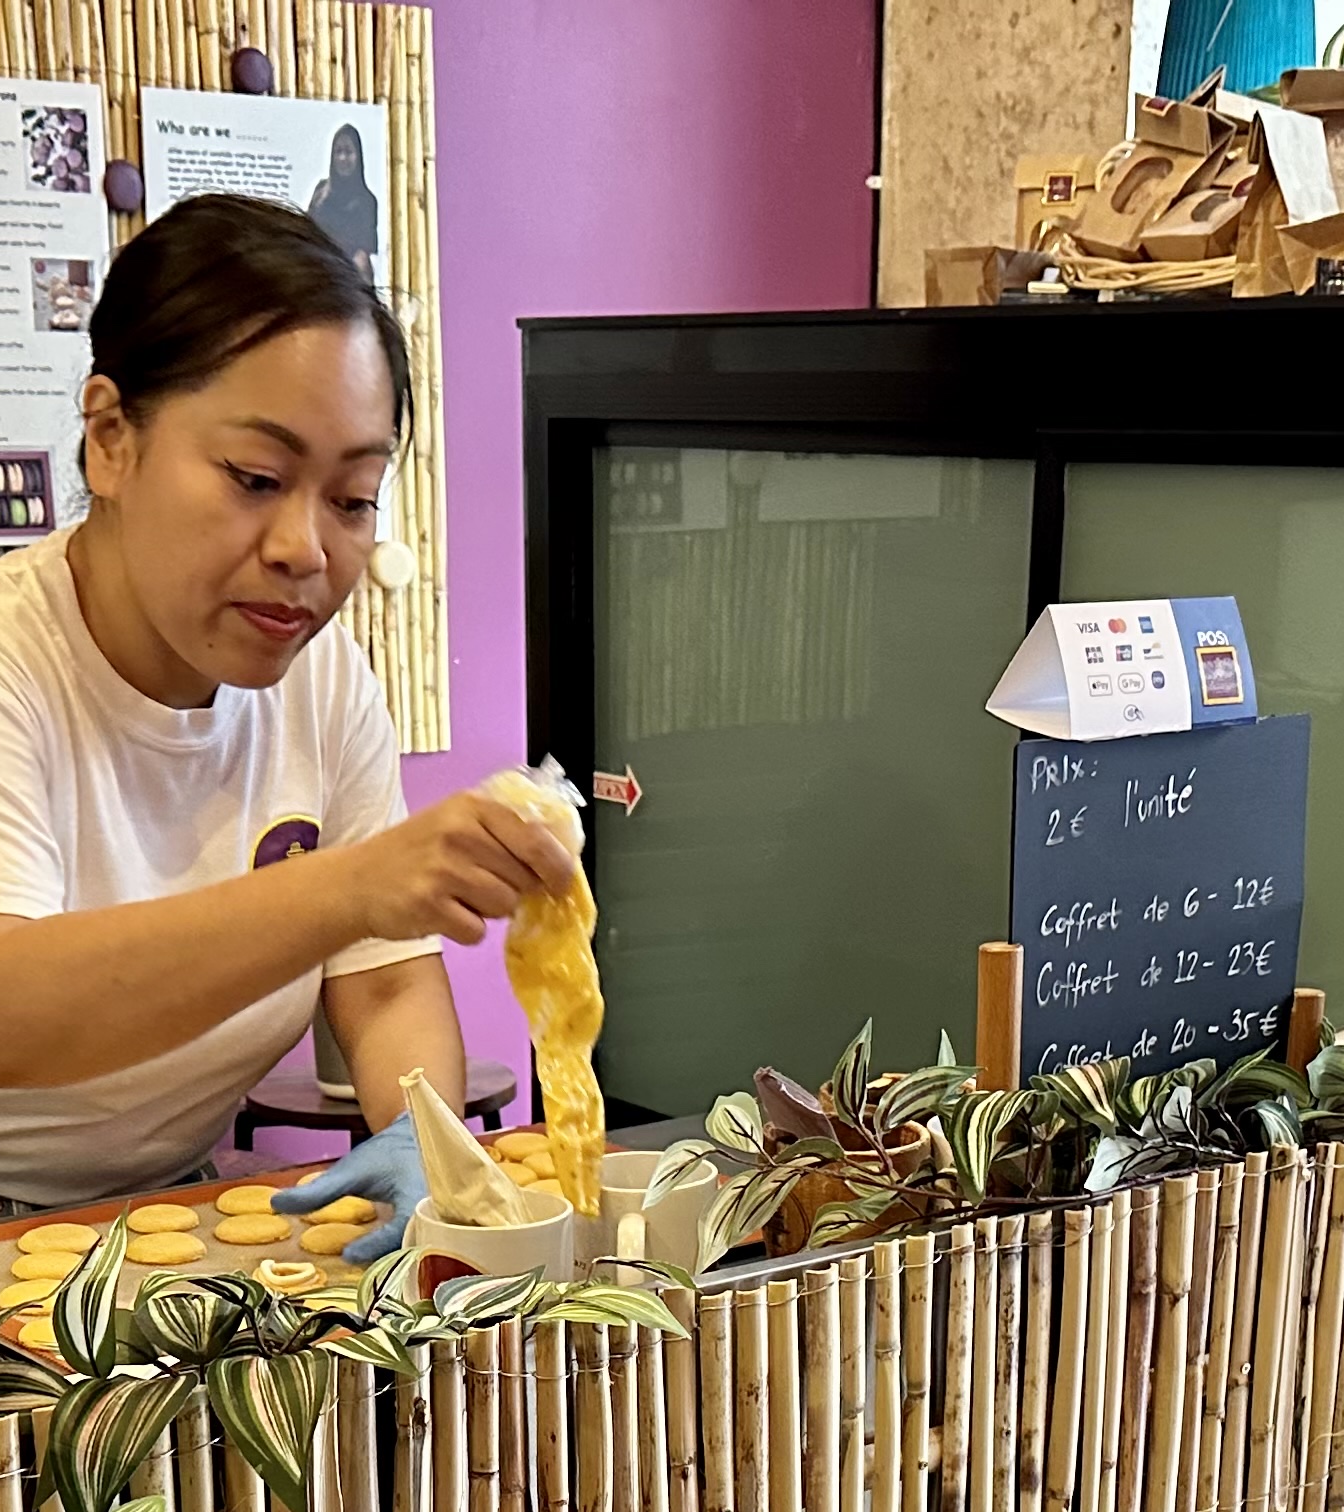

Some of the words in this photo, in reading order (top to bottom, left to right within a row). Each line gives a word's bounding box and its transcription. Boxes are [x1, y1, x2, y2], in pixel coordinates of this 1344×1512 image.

[156, 119, 184, 134] Who
[189, 126, 209, 136] are
[214, 128, 230, 138] we
[1075, 622, 1101, 634] VISA
[1124, 767, 1197, 827] l'unité
[1040, 898, 1123, 948] Coffret
[1143, 895, 1169, 922] de
[1183, 887, 1200, 918] 6
[1232, 876, 1275, 911] 12€
[1036, 960, 1119, 1008] Coffret
[1140, 955, 1162, 988] de
[1227, 940, 1276, 977] 23€
[1132, 1028, 1158, 1060] de
[1170, 1018, 1197, 1054] 20
